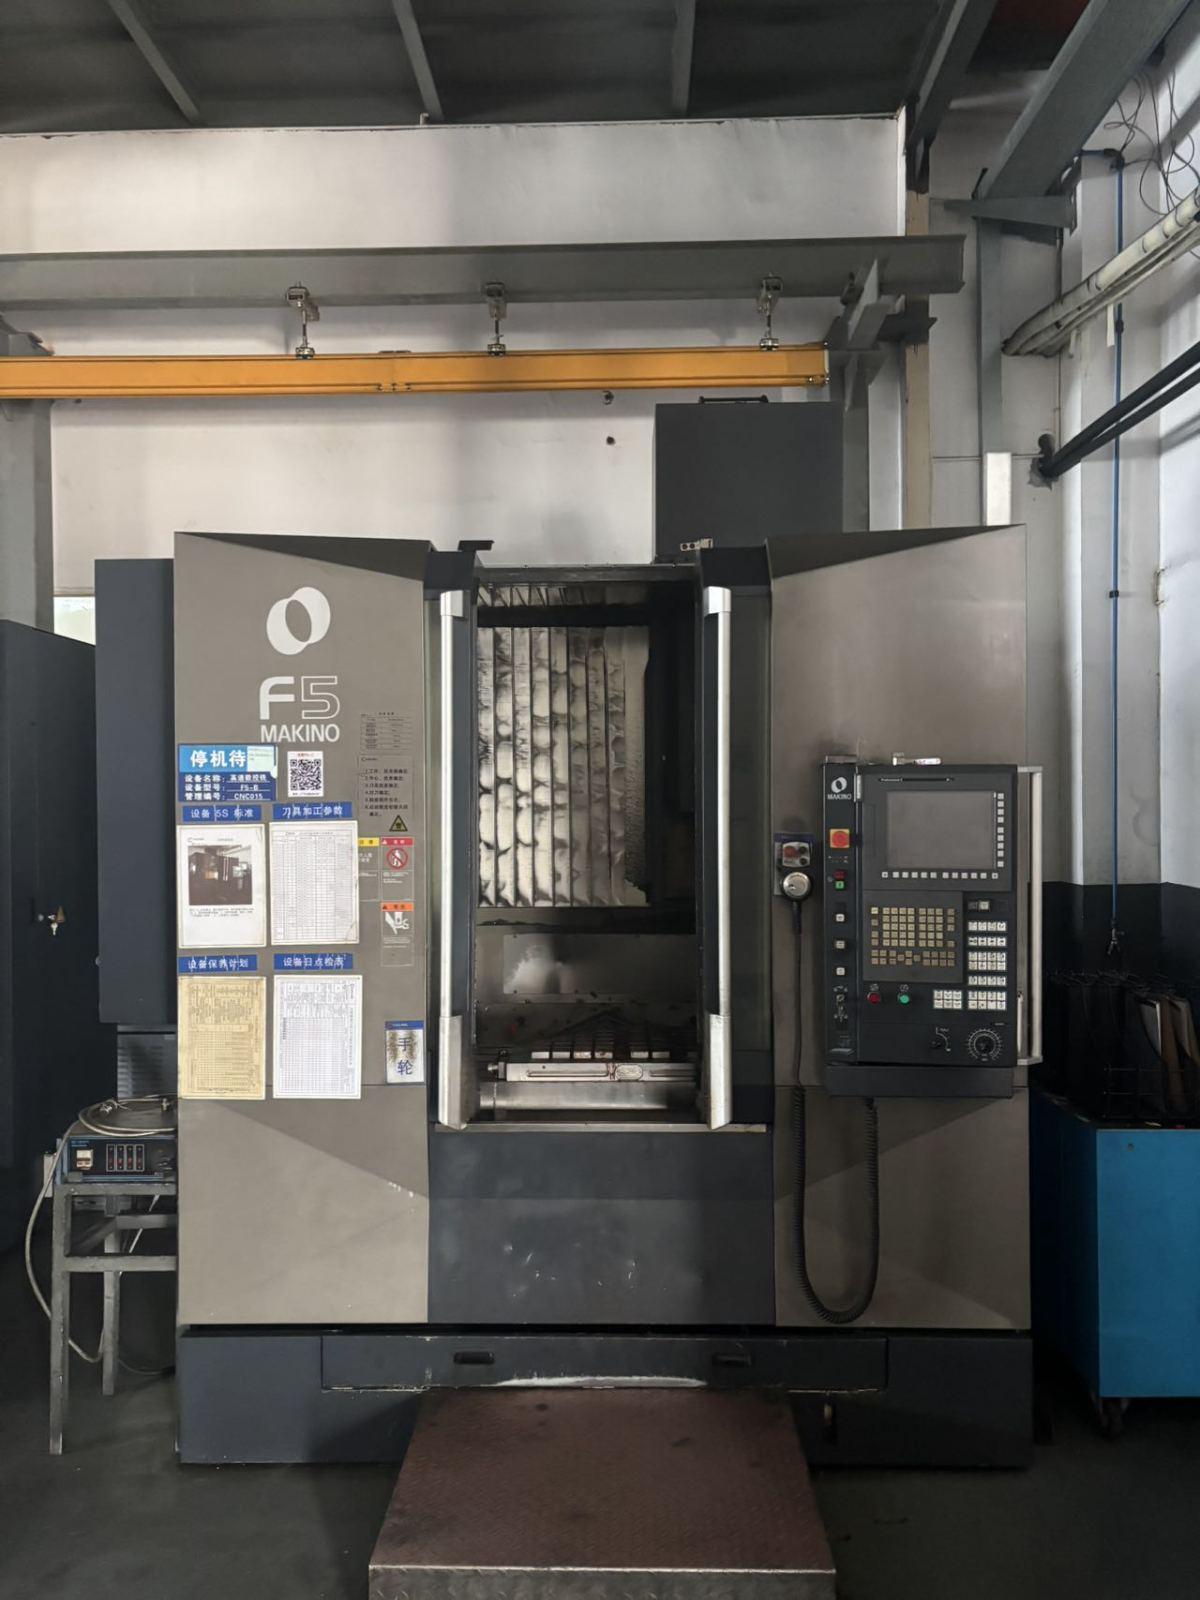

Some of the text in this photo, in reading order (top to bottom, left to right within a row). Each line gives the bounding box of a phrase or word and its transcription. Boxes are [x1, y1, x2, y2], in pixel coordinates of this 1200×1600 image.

[259, 675, 340, 720] F5
[260, 723, 340, 743] MAKINO
[190, 808, 210, 819] 设备
[215, 808, 229, 818] 5S
[282, 806, 343, 818] 刀具加工参数
[396, 1036, 413, 1076] 手轮
